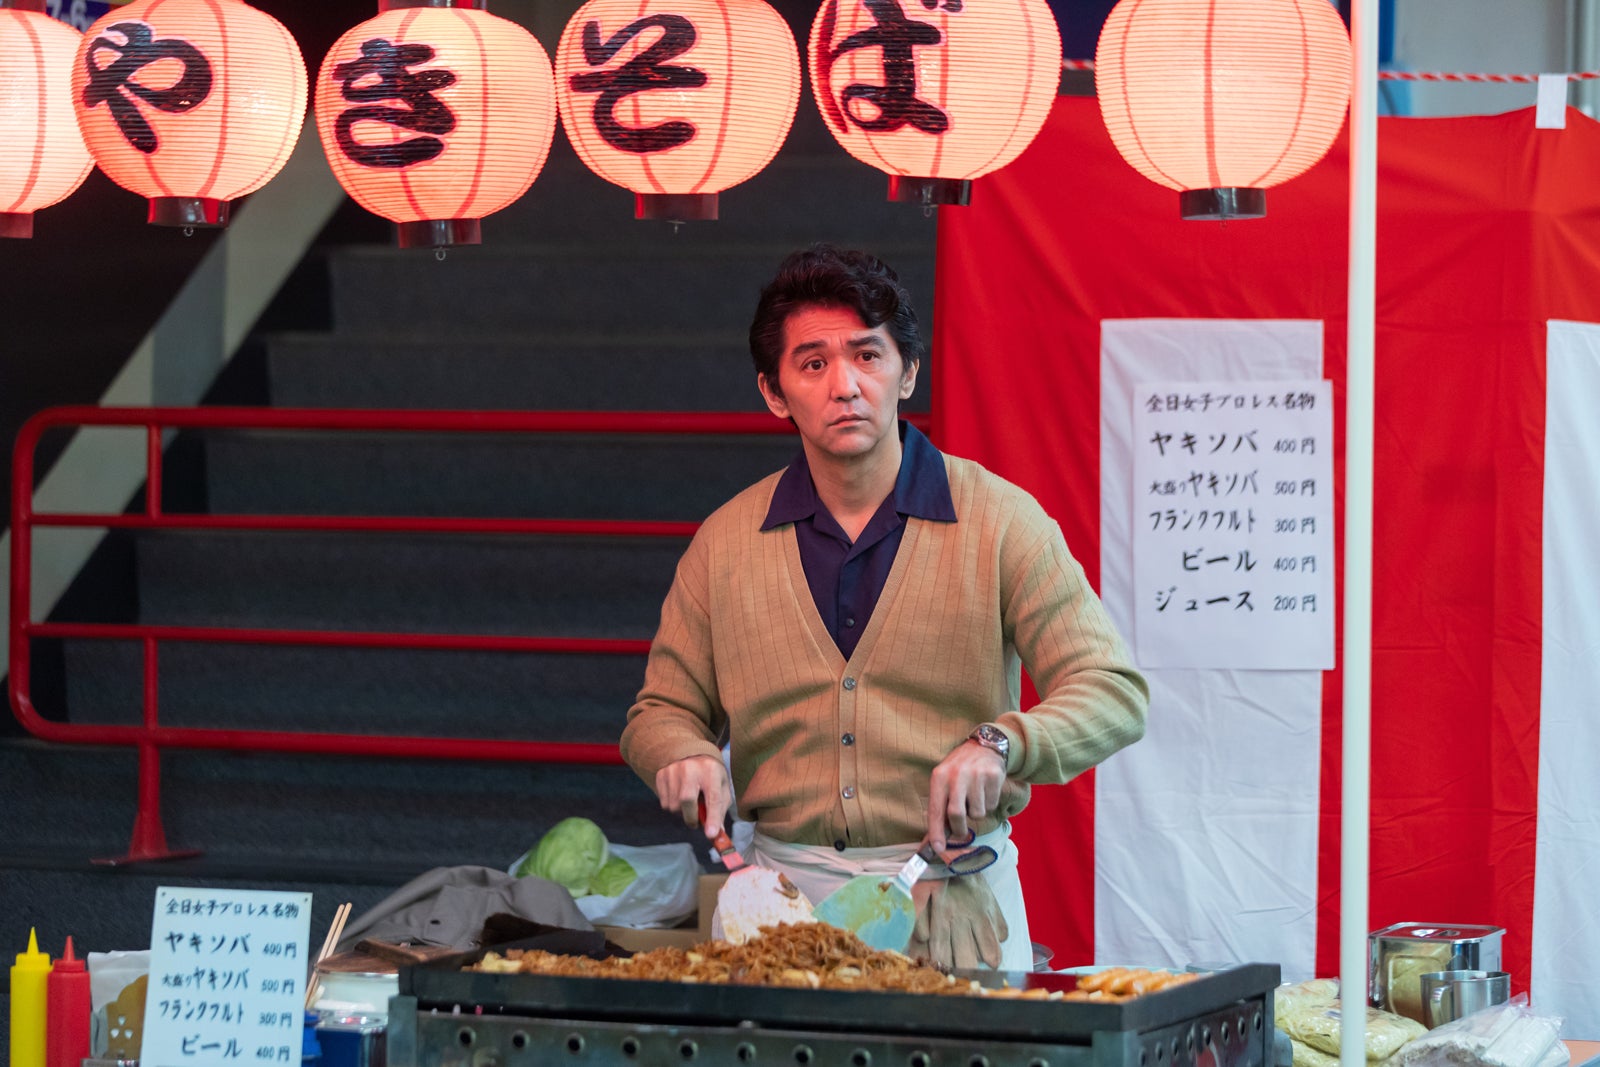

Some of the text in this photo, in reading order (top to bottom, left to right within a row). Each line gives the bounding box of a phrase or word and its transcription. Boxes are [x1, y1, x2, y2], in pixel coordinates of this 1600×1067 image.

[1146, 392, 1316, 413] 全日女子プロレス名物
[1150, 430, 1316, 456] ヤキソバ 400円
[1149, 469, 1316, 497] 大盛りヤキソバ 500円
[1149, 508, 1316, 534] フランクフルト 300円
[1182, 548, 1316, 573] ビール 400円
[1155, 586, 1317, 612] ジュース 200円
[166, 897, 299, 919] 全日女子プロレス名物
[165, 931, 297, 959] ヤキソバ 400円
[162, 966, 295, 995] 大盛りヤキソバ 500円
[160, 999, 292, 1028] フランクフルト 300円
[182, 1034, 290, 1062] ビール 400円
